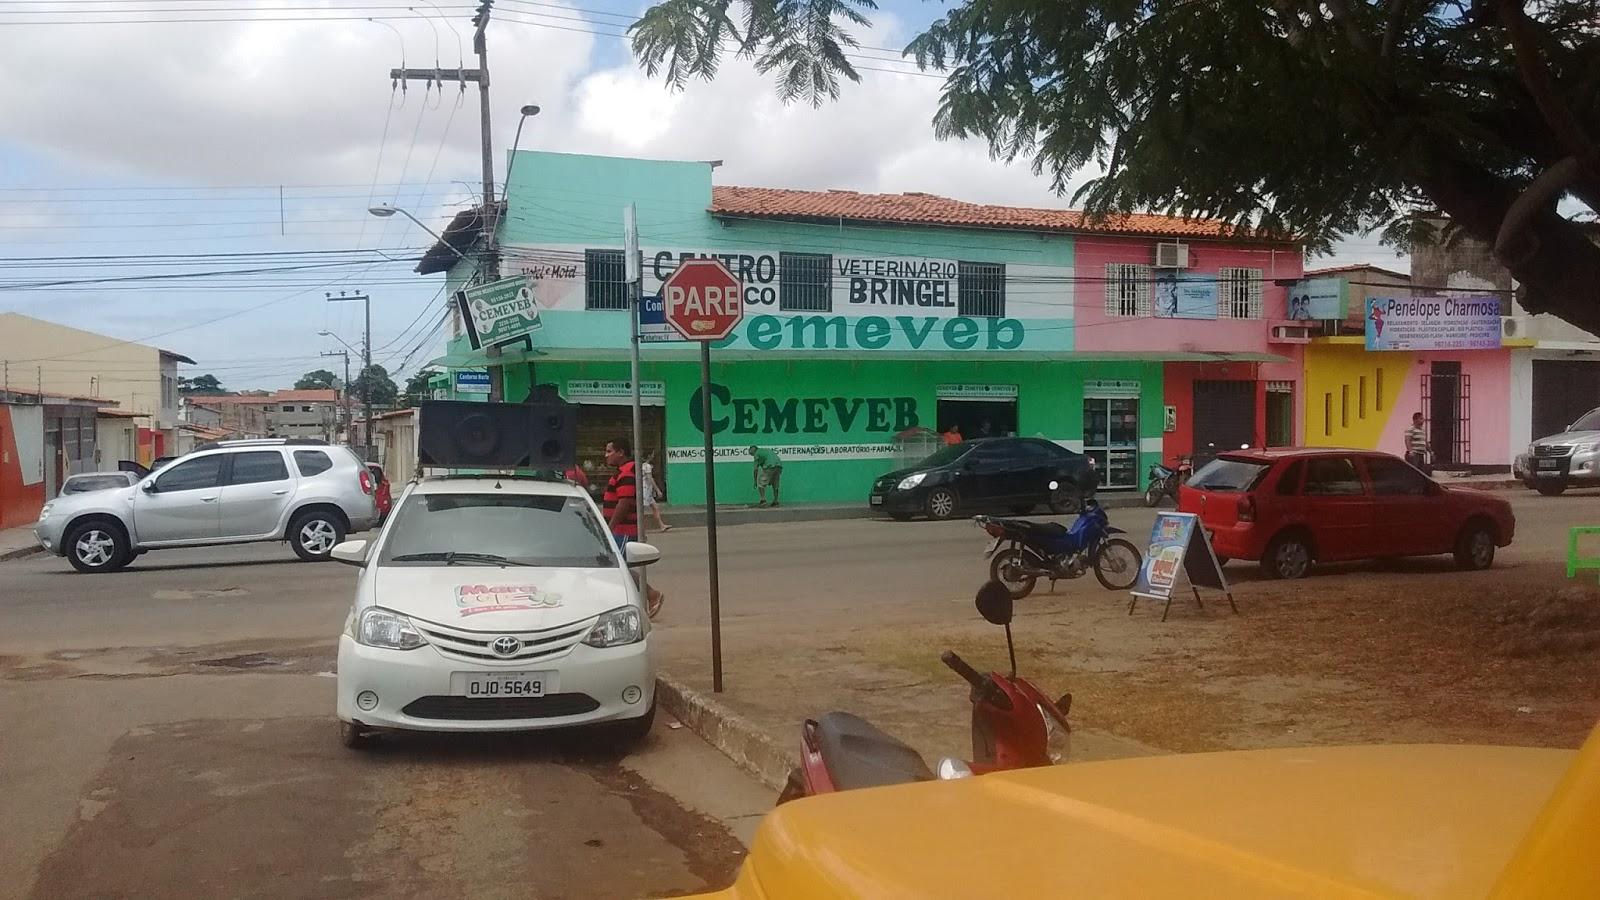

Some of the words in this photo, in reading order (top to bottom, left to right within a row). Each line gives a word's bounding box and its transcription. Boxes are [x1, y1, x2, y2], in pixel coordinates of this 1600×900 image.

[654, 251, 776, 284] CTRO
[838, 258, 957, 279] VETERINÁRIO
[668, 286, 738, 316] PARE
[849, 278, 956, 308] BRINGEL
[479, 299, 532, 321] CEMEVEB
[1387, 299, 1440, 320] Penélope
[1445, 298, 1499, 316] Charmosa
[689, 382, 920, 435] CEMEVEB
[668, 449, 697, 459] VACINAS
